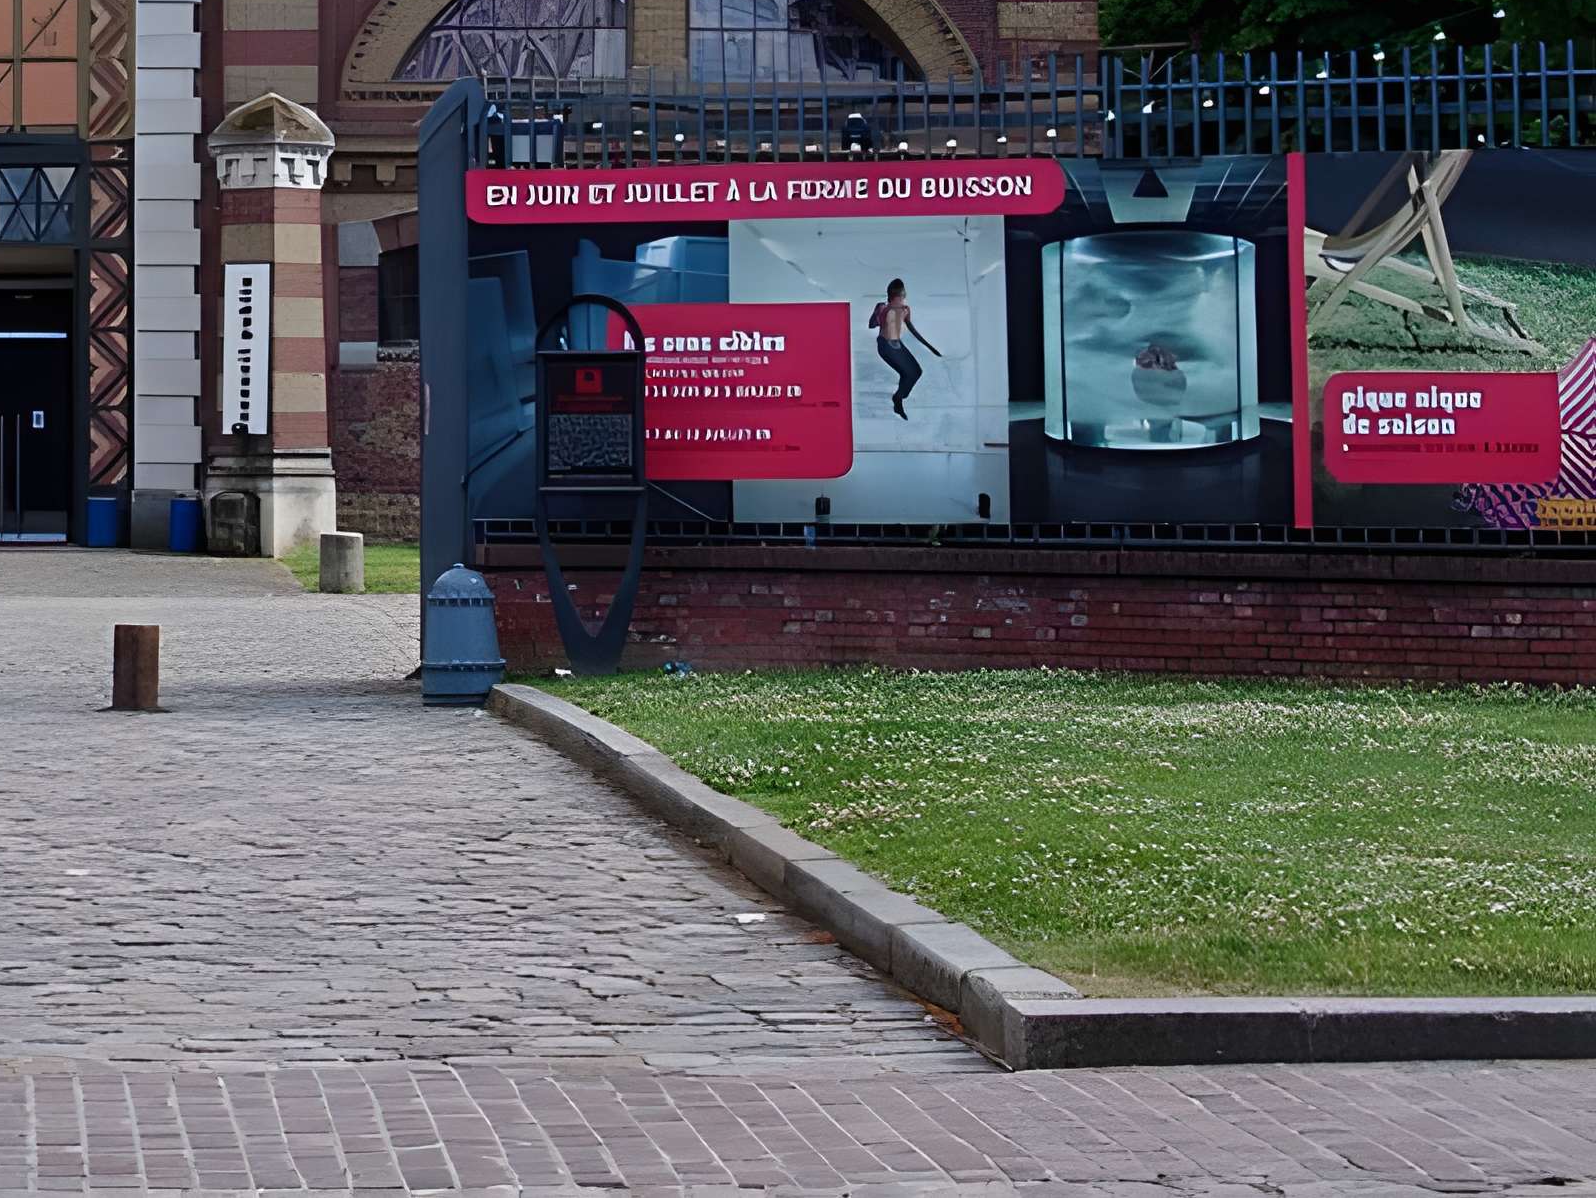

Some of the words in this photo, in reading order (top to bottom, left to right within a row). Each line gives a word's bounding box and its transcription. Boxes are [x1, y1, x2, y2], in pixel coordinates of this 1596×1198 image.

[525, 184, 580, 206] JUIN
[623, 181, 720, 204] JUILLET
[749, 181, 778, 202] LA
[878, 177, 911, 199] DU
[921, 175, 1032, 198] BUISSON
